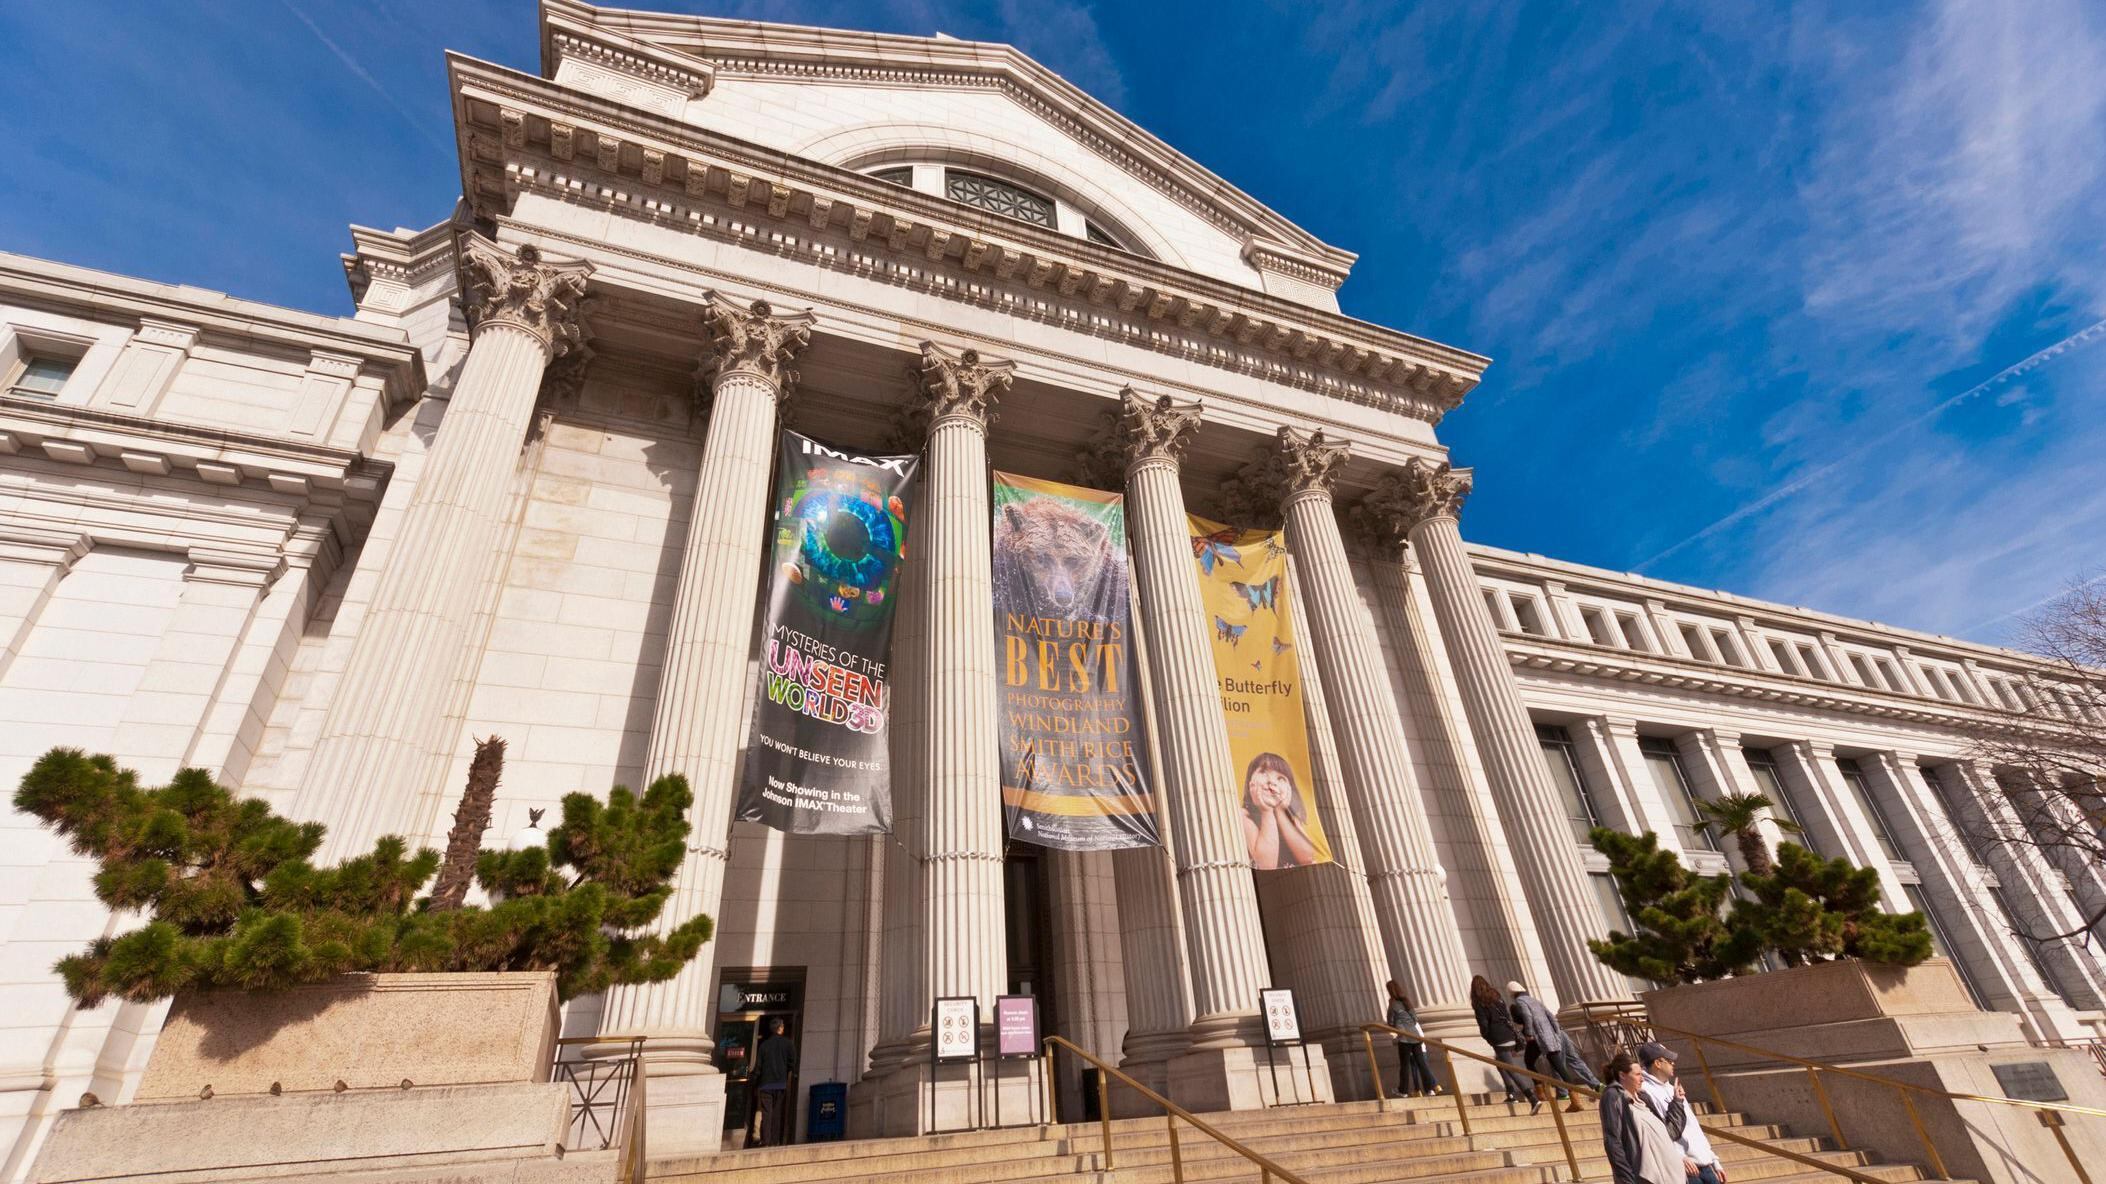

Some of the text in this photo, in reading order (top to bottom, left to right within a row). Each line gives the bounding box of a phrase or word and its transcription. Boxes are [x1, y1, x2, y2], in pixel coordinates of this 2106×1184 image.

[802, 440, 905, 478] IMAX
[1007, 612, 1122, 640] NATURE'S
[771, 622, 886, 679] MYSTERIES OF THE
[1004, 634, 1124, 693] BEST
[768, 638, 883, 709] UNSEEN
[1225, 677, 1292, 697] Butterfly
[1007, 692, 1126, 712] PHOTOGRAPHY
[1007, 710, 1131, 734] WINDLAND
[760, 733, 774, 748] YOU
[774, 740, 798, 756] WON'T
[798, 749, 831, 765] BELIEVE
[832, 756, 857, 769] YOUR
[1010, 733, 1133, 759] SMITH RICE
[1015, 758, 1137, 787] AWARDS
[762, 787, 793, 807] Johnson
[826, 801, 868, 814] Theater
[768, 775, 861, 802] Now Showing in the
